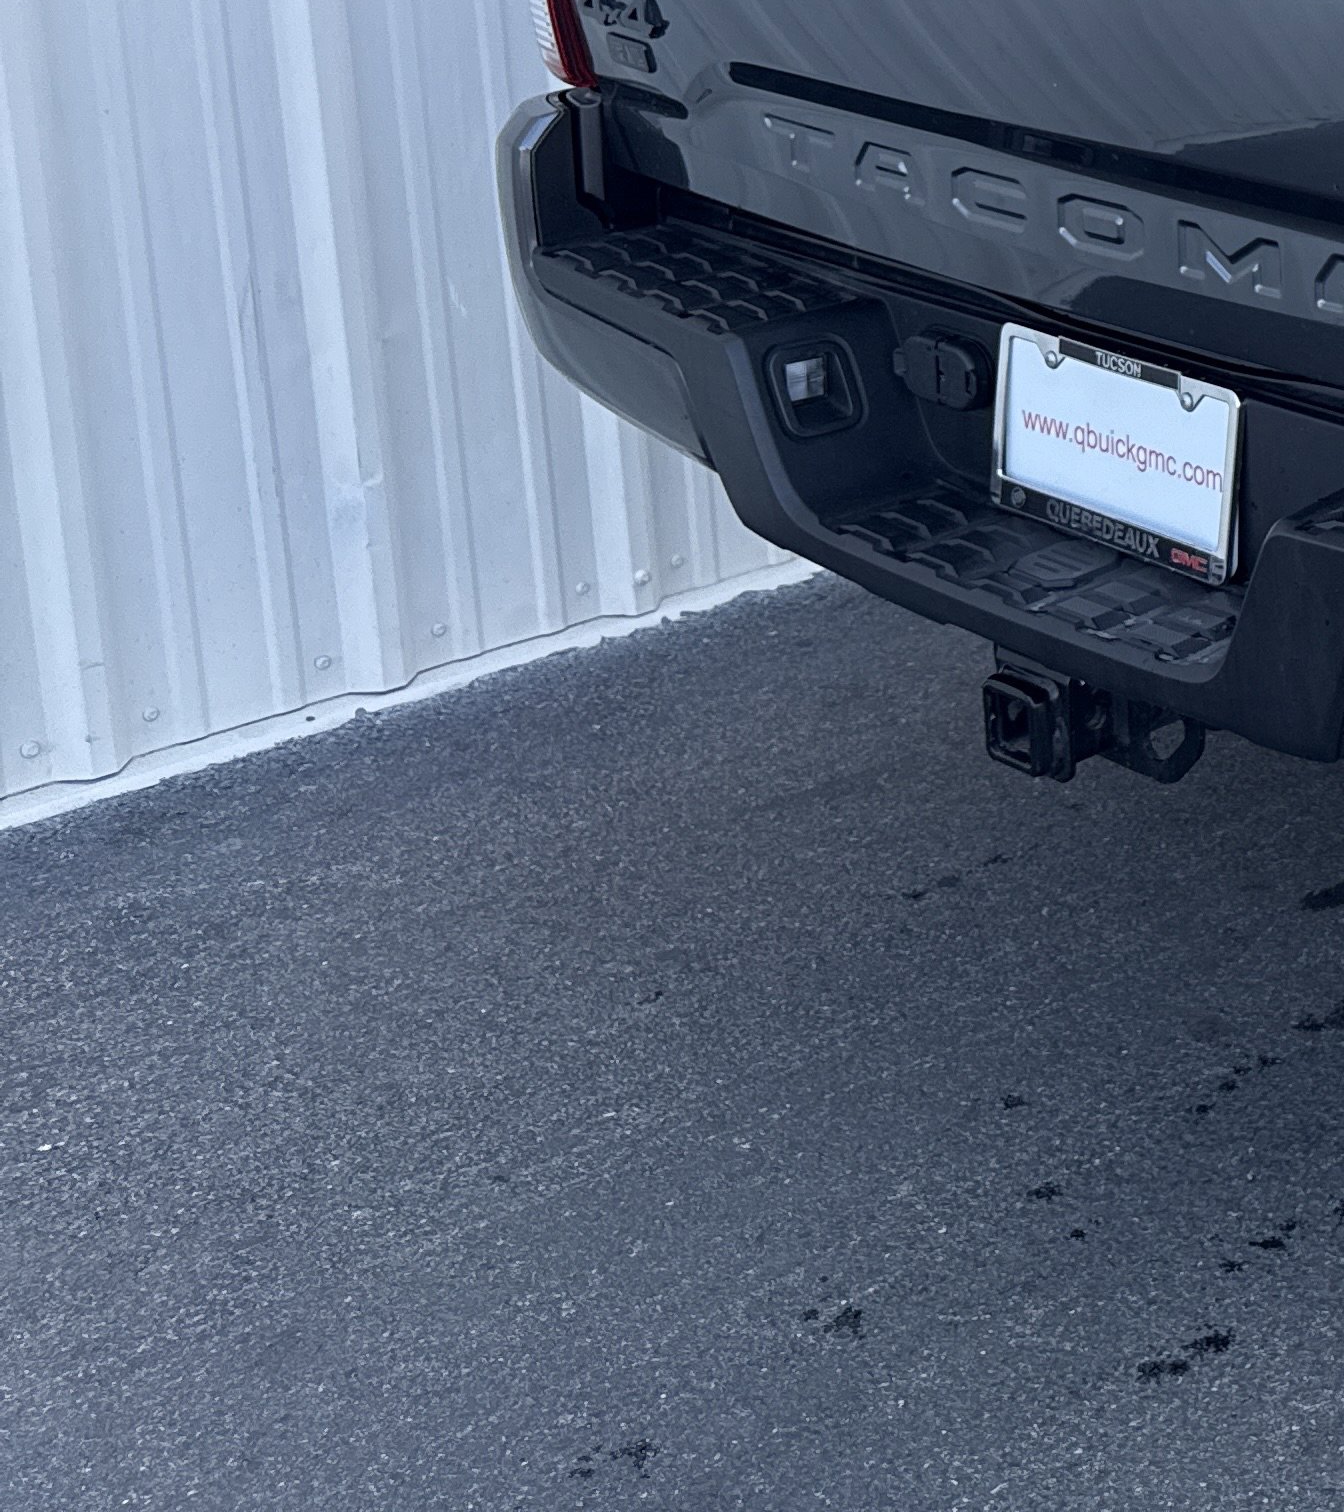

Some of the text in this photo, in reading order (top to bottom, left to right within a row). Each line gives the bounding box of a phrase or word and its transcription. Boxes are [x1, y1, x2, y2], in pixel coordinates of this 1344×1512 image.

[1095, 350, 1143, 379] TUCSON
[1020, 409, 1224, 493] www.qbuickgmc.com
[1045, 500, 1160, 559] QUEBEDEAUX
[1170, 547, 1209, 573] GMC
